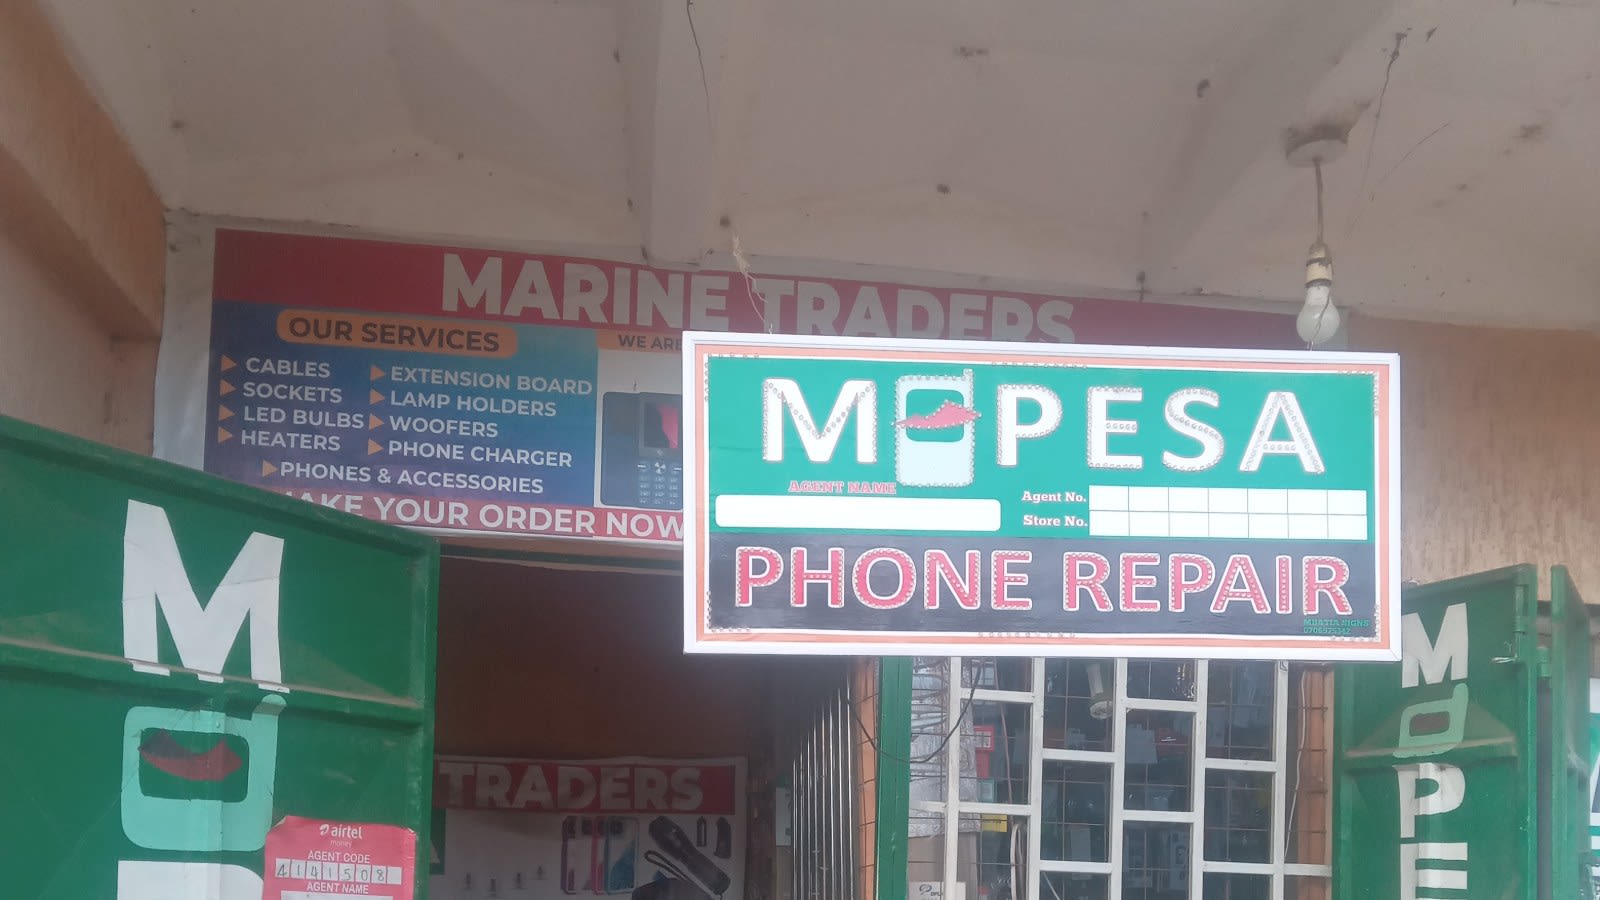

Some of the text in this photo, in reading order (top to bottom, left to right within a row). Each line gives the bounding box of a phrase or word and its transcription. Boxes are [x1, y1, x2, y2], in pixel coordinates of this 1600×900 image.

[442, 253, 1075, 343] MARINE TRADERS
[289, 317, 500, 352] OUR SERVICES
[618, 334, 646, 348] WE
[245, 357, 331, 378] CABLES
[391, 366, 593, 395] EXTENSION BOARD
[243, 382, 342, 404] SOCKETS
[391, 390, 557, 417] LAMP HOLDERS
[243, 405, 364, 429] LED BULBS
[389, 415, 498, 438] WOOFERS
[762, 376, 1325, 474] M PESA
[241, 429, 341, 451] HEATERS
[388, 440, 572, 467] PHONE CHARGER
[280, 460, 544, 494] PHONES & ACCESSORIES
[788, 480, 897, 494] AGENT NAME
[1021, 490, 1087, 504] Agent No.
[373, 496, 469, 526] YOUR
[478, 503, 594, 534] ORDER
[606, 511, 684, 539] NOW
[1023, 514, 1088, 527] Store No.
[735, 546, 1353, 615] PHONE REPAIR
[438, 761, 704, 811] TRADERS
[330, 839, 352, 848] money
[331, 824, 363, 840] airtel
[307, 850, 371, 864] AGENT CODE
[306, 882, 369, 894] AGENT NAME
